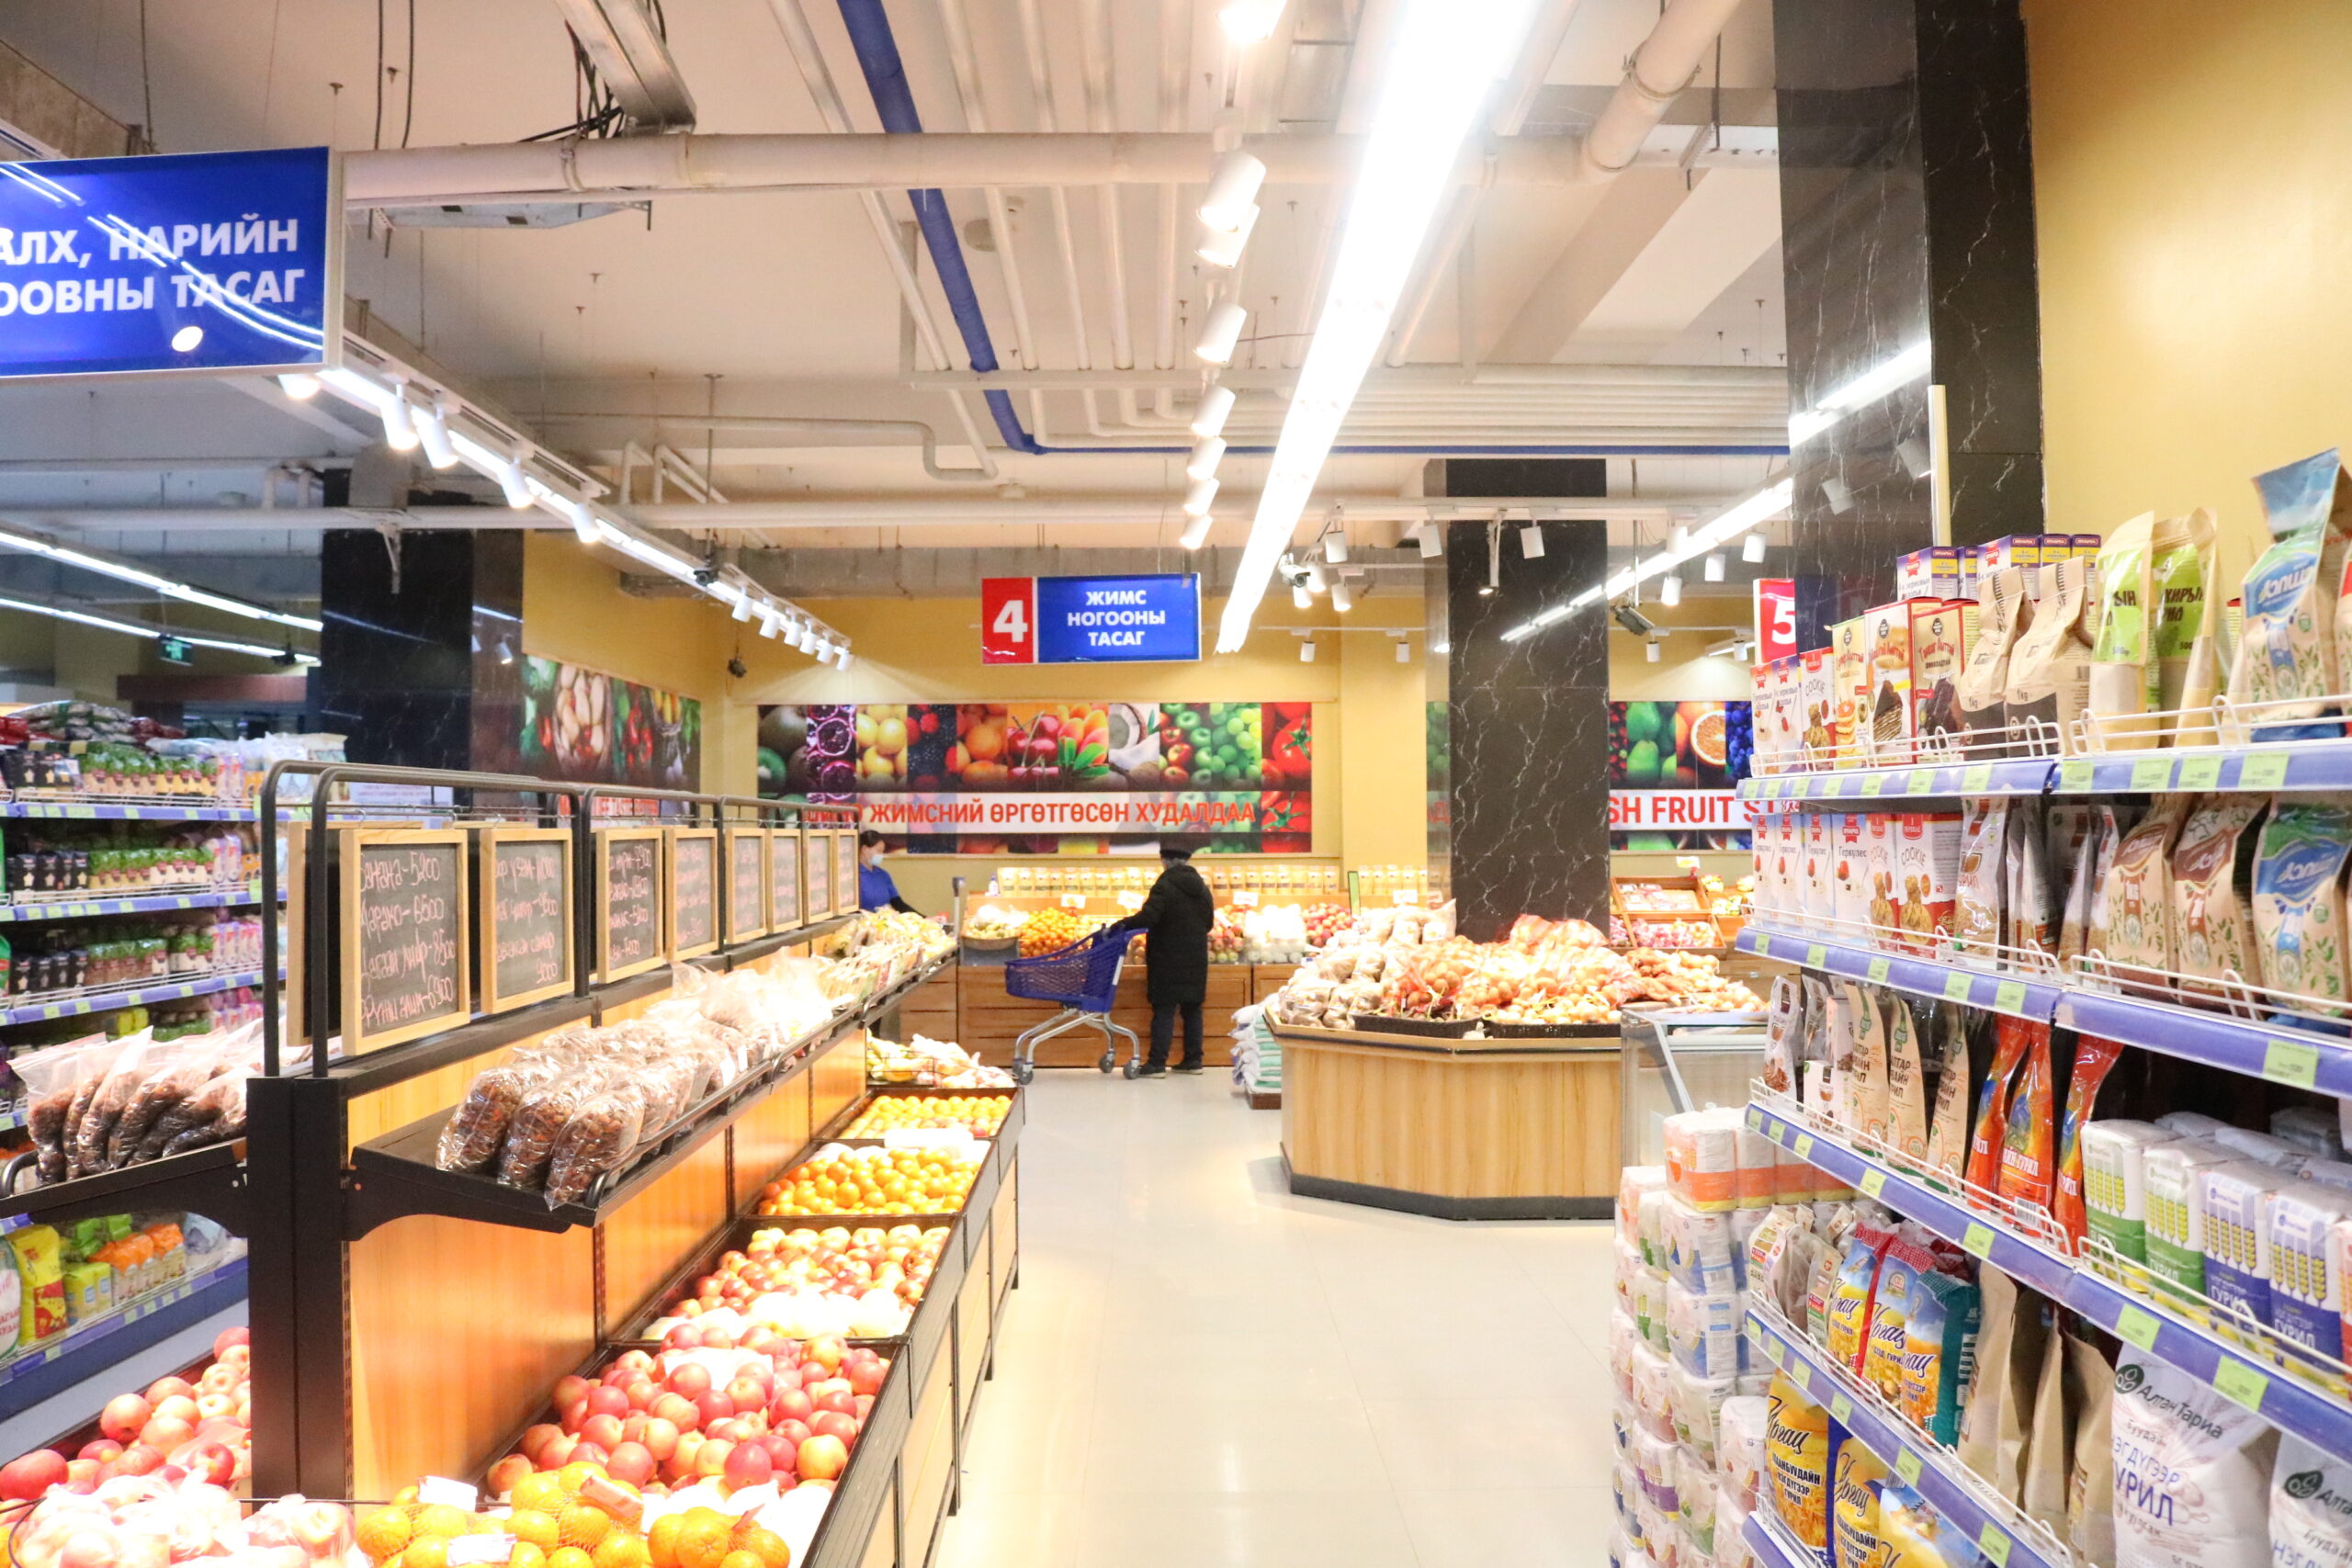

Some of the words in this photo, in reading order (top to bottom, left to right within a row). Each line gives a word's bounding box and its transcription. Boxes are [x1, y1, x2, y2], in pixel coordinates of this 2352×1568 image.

[109, 213, 299, 261] НАРИЙН
[171, 269, 305, 308] ТАСАГ
[1086, 590, 1147, 605] ЖИМС
[993, 600, 1028, 642] 4
[1068, 610, 1166, 626] НОГООНЫ
[1771, 599, 1796, 645] 5
[1088, 631, 1145, 646] ТАСАГ
[869, 798, 983, 823] ЖИМСНИЙ
[989, 802, 1130, 823] ӨРГӨТГӨСӨН
[1136, 802, 1256, 826] ХУДАЛДАА
[1652, 795, 1735, 823] FRUIT
[1901, 846, 1927, 867] COOKIE
[2136, 1385, 2178, 1412] Алтан
[2176, 1402, 2224, 1439] Тариа
